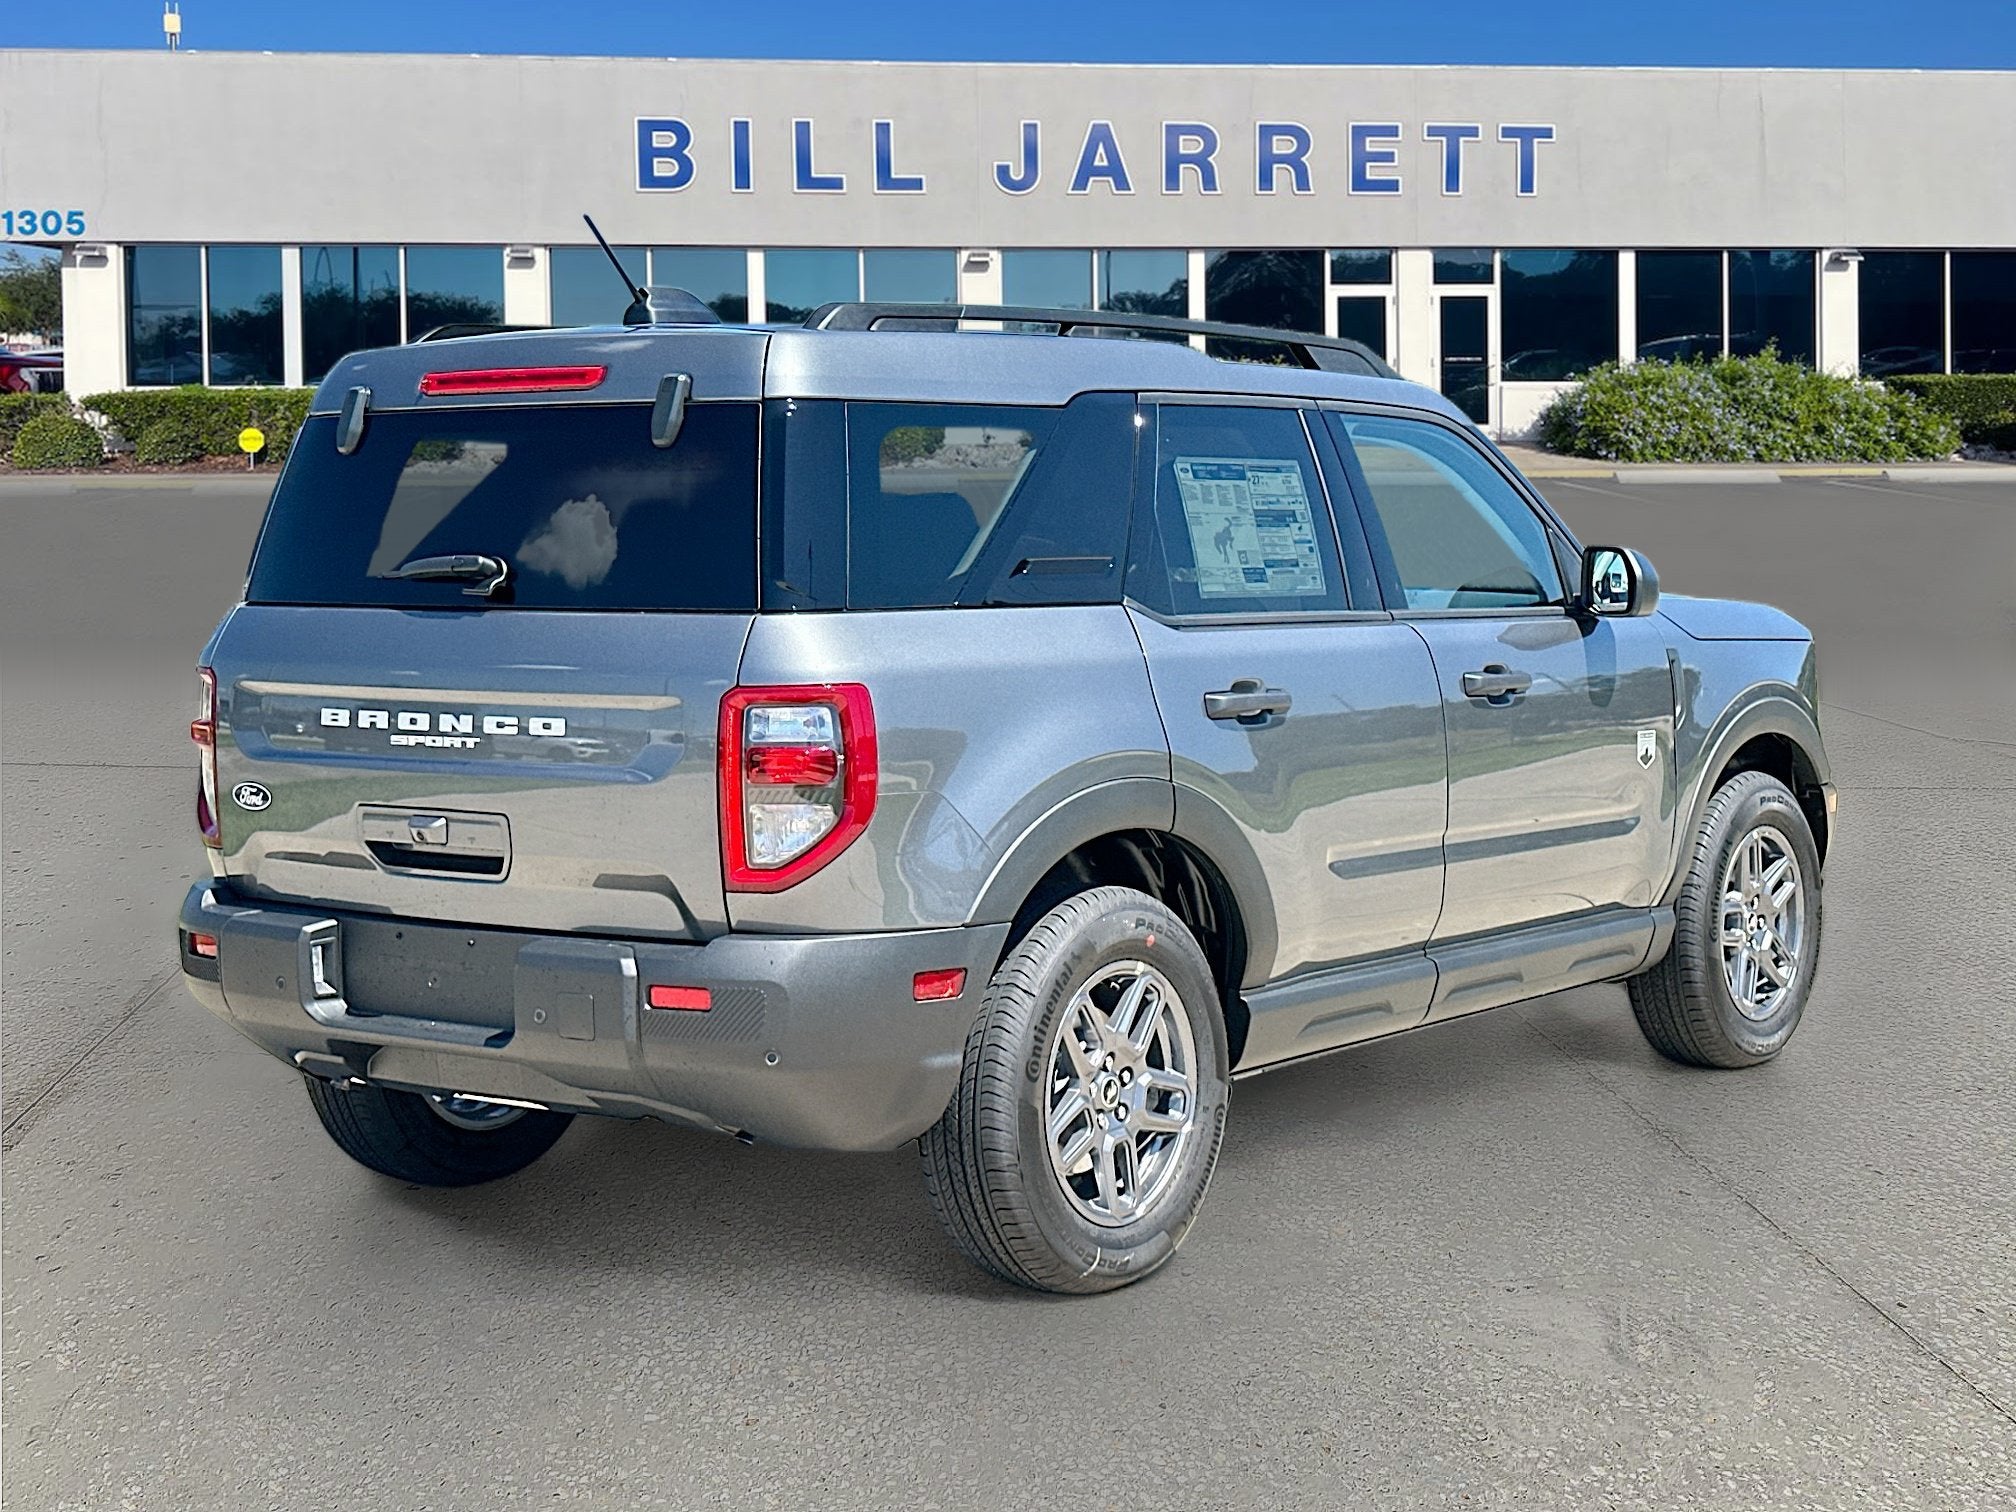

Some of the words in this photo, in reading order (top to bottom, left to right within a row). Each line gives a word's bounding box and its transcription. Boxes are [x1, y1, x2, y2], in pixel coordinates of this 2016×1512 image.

[634, 116, 927, 195] BILL
[993, 120, 1557, 197] JARRETT
[1, 209, 86, 236] 1305
[320, 707, 567, 737] BRONCO
[390, 734, 481, 749] SPORT
[238, 785, 266, 807] Ford
[1025, 960, 1074, 1084] Continental
